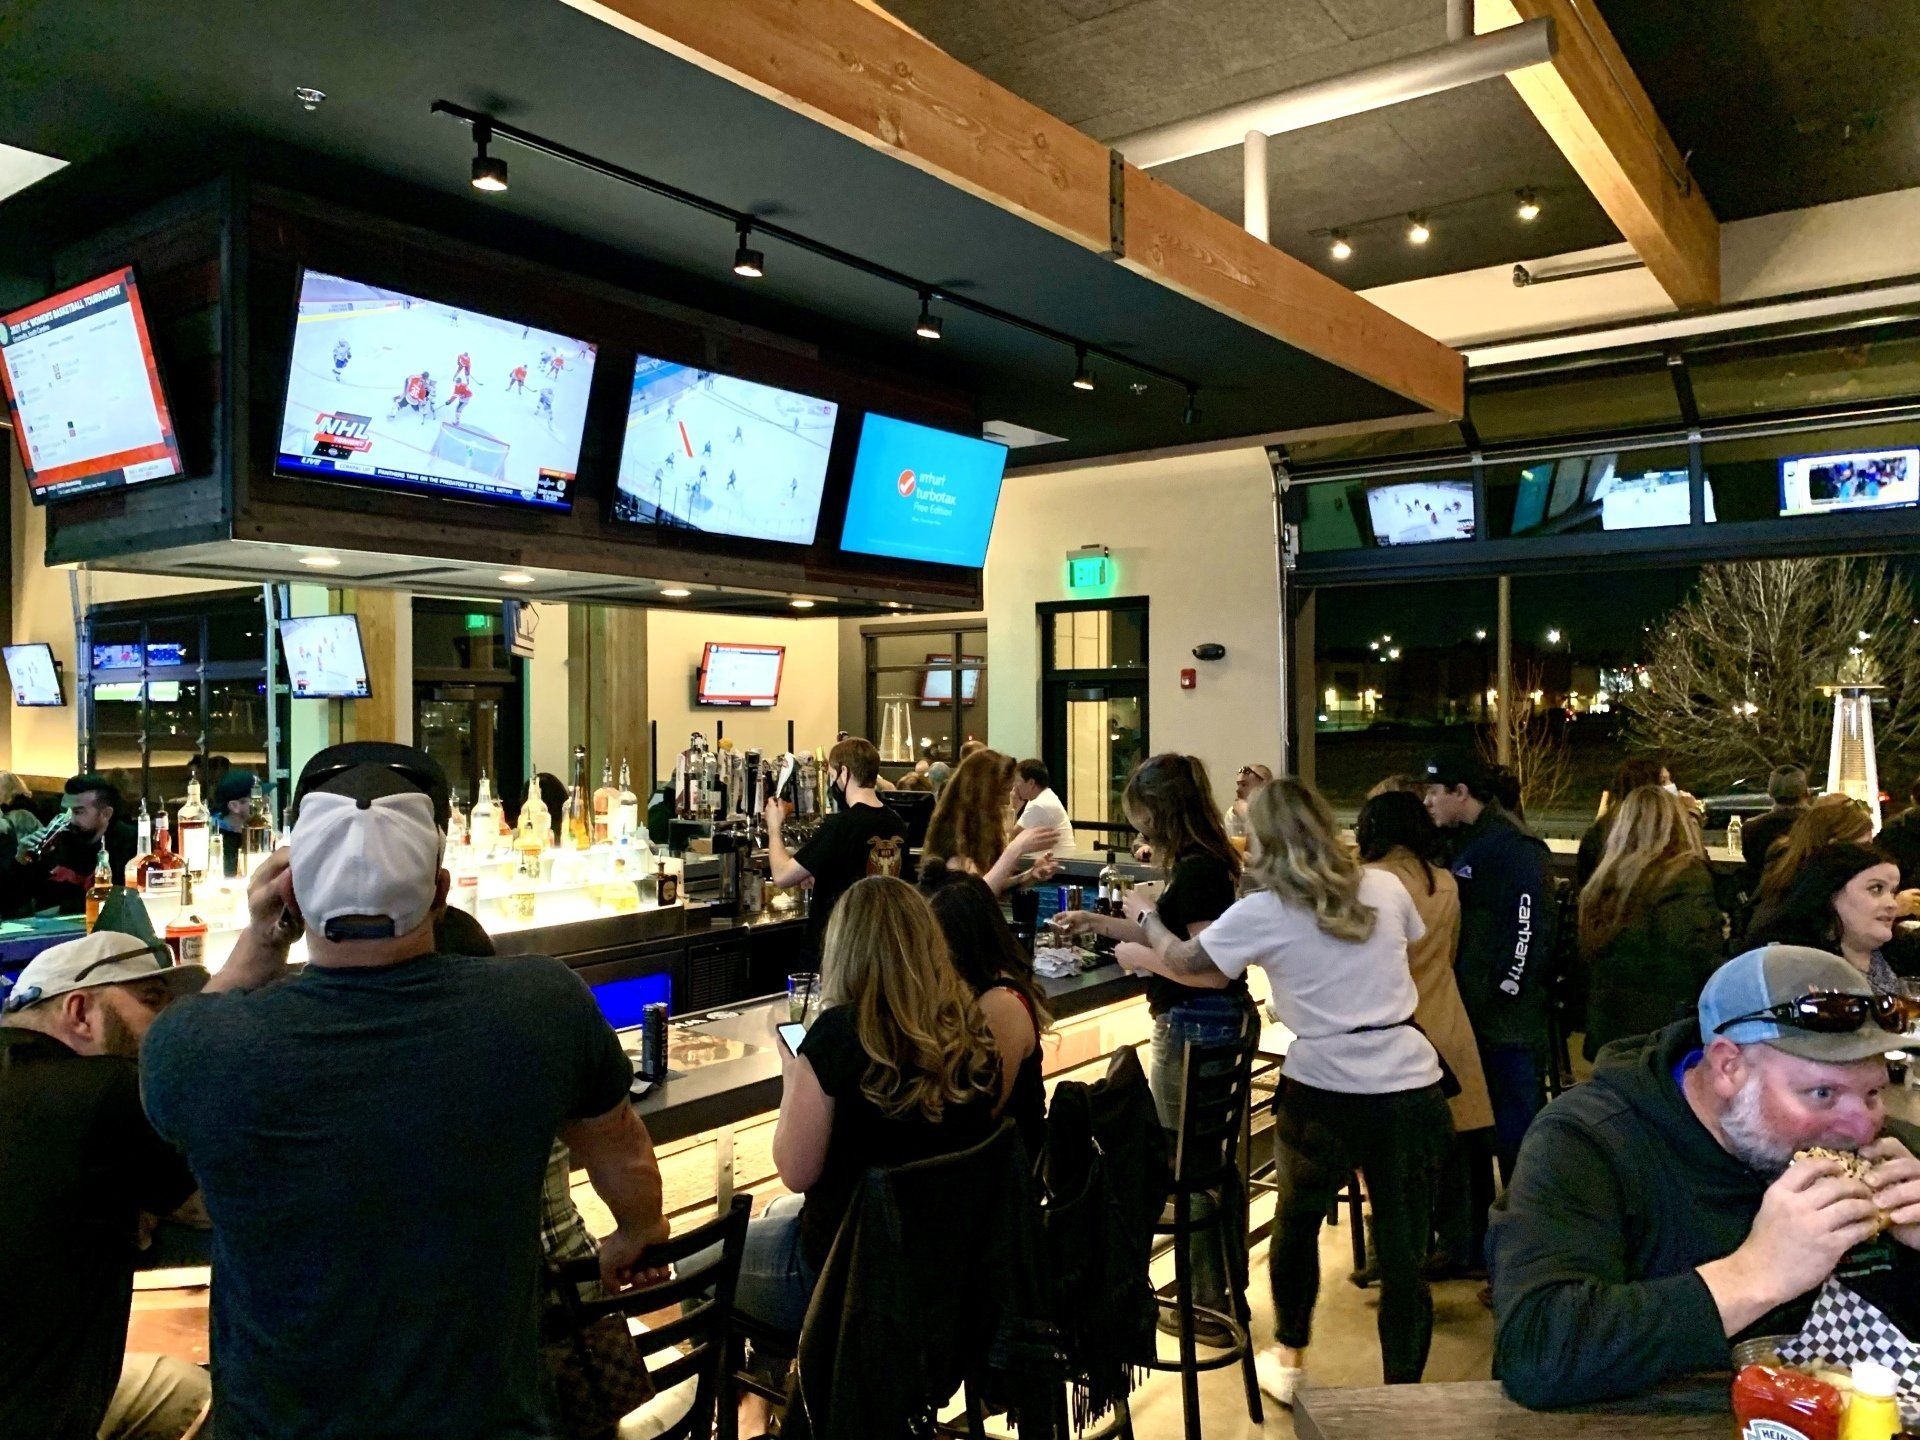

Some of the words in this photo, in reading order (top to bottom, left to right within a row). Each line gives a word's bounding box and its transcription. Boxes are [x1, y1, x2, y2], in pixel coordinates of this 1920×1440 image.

[53, 299, 85, 320] BASKETBALL
[84, 284, 121, 307] TOURNAMENT
[317, 416, 370, 440] NHL
[301, 457, 322, 466] LIVE
[377, 469, 405, 479] PANTHERS
[406, 473, 419, 481] TAKE
[429, 476, 439, 484] THE
[439, 478, 468, 488] PREDATORS
[916, 488, 957, 505] turbotax
[913, 501, 929, 512] Free
[929, 504, 953, 516] Edition
[1508, 893, 1533, 981] carhartt
